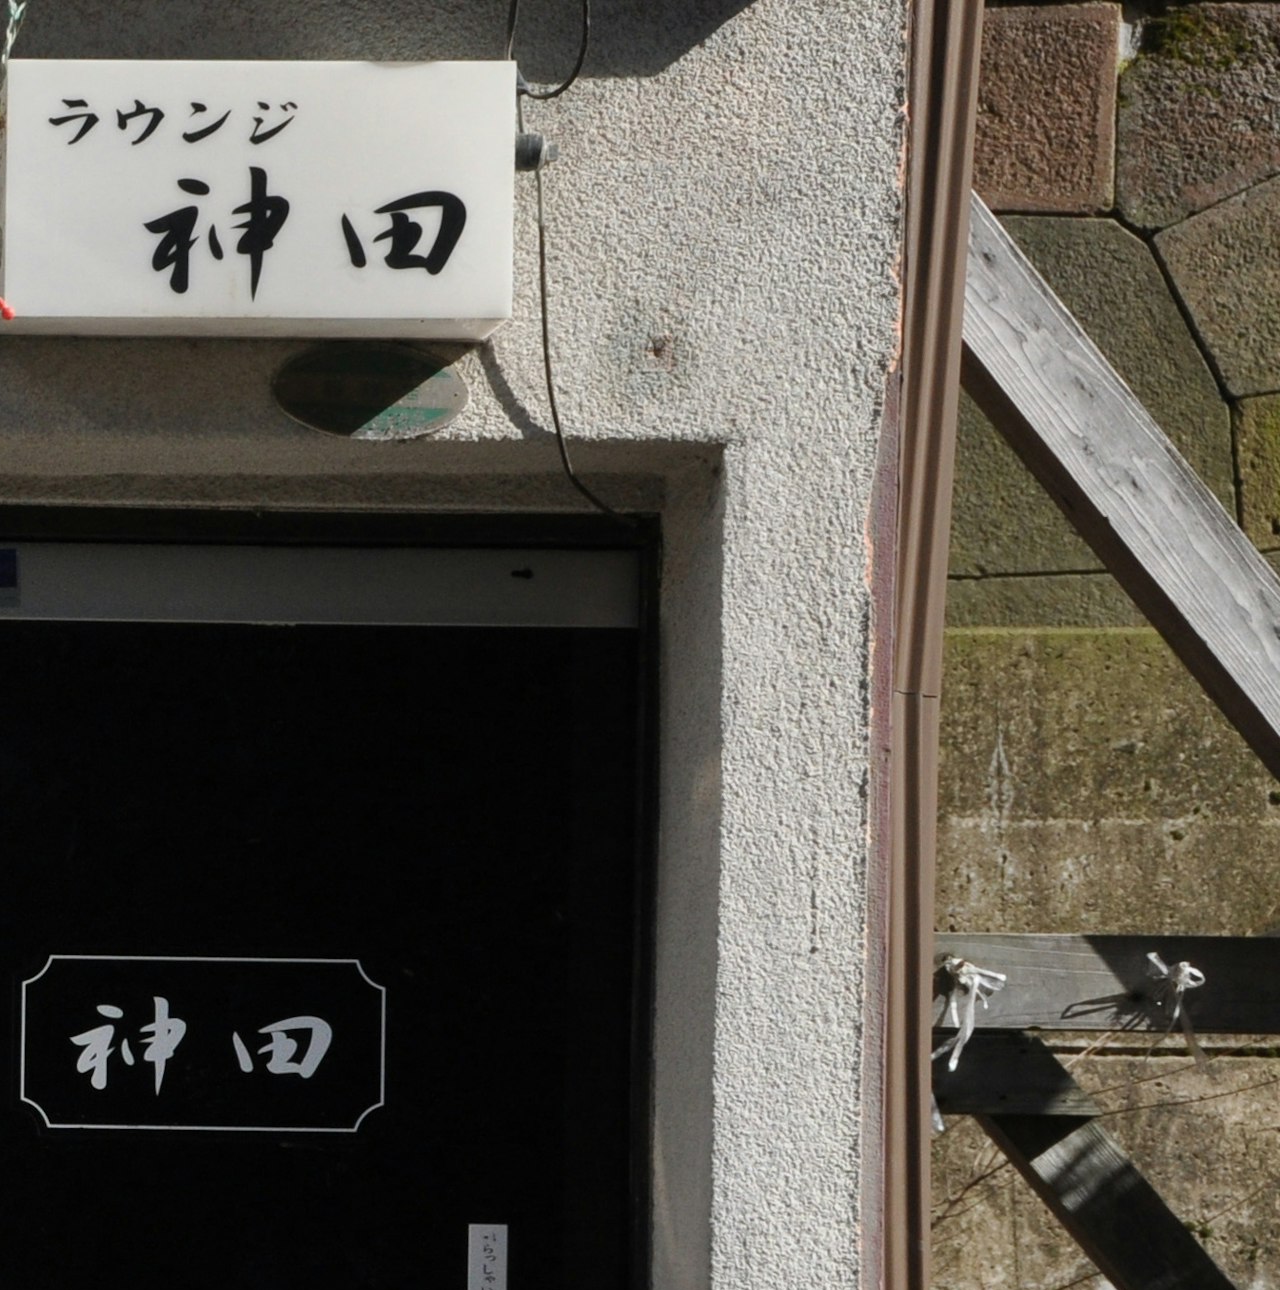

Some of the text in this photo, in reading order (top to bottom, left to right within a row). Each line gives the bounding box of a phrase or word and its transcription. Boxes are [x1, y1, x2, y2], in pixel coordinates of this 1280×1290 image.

[48, 99, 299, 146] ラウンジ
[142, 166, 467, 302] 神田
[69, 996, 333, 1096] 神田
